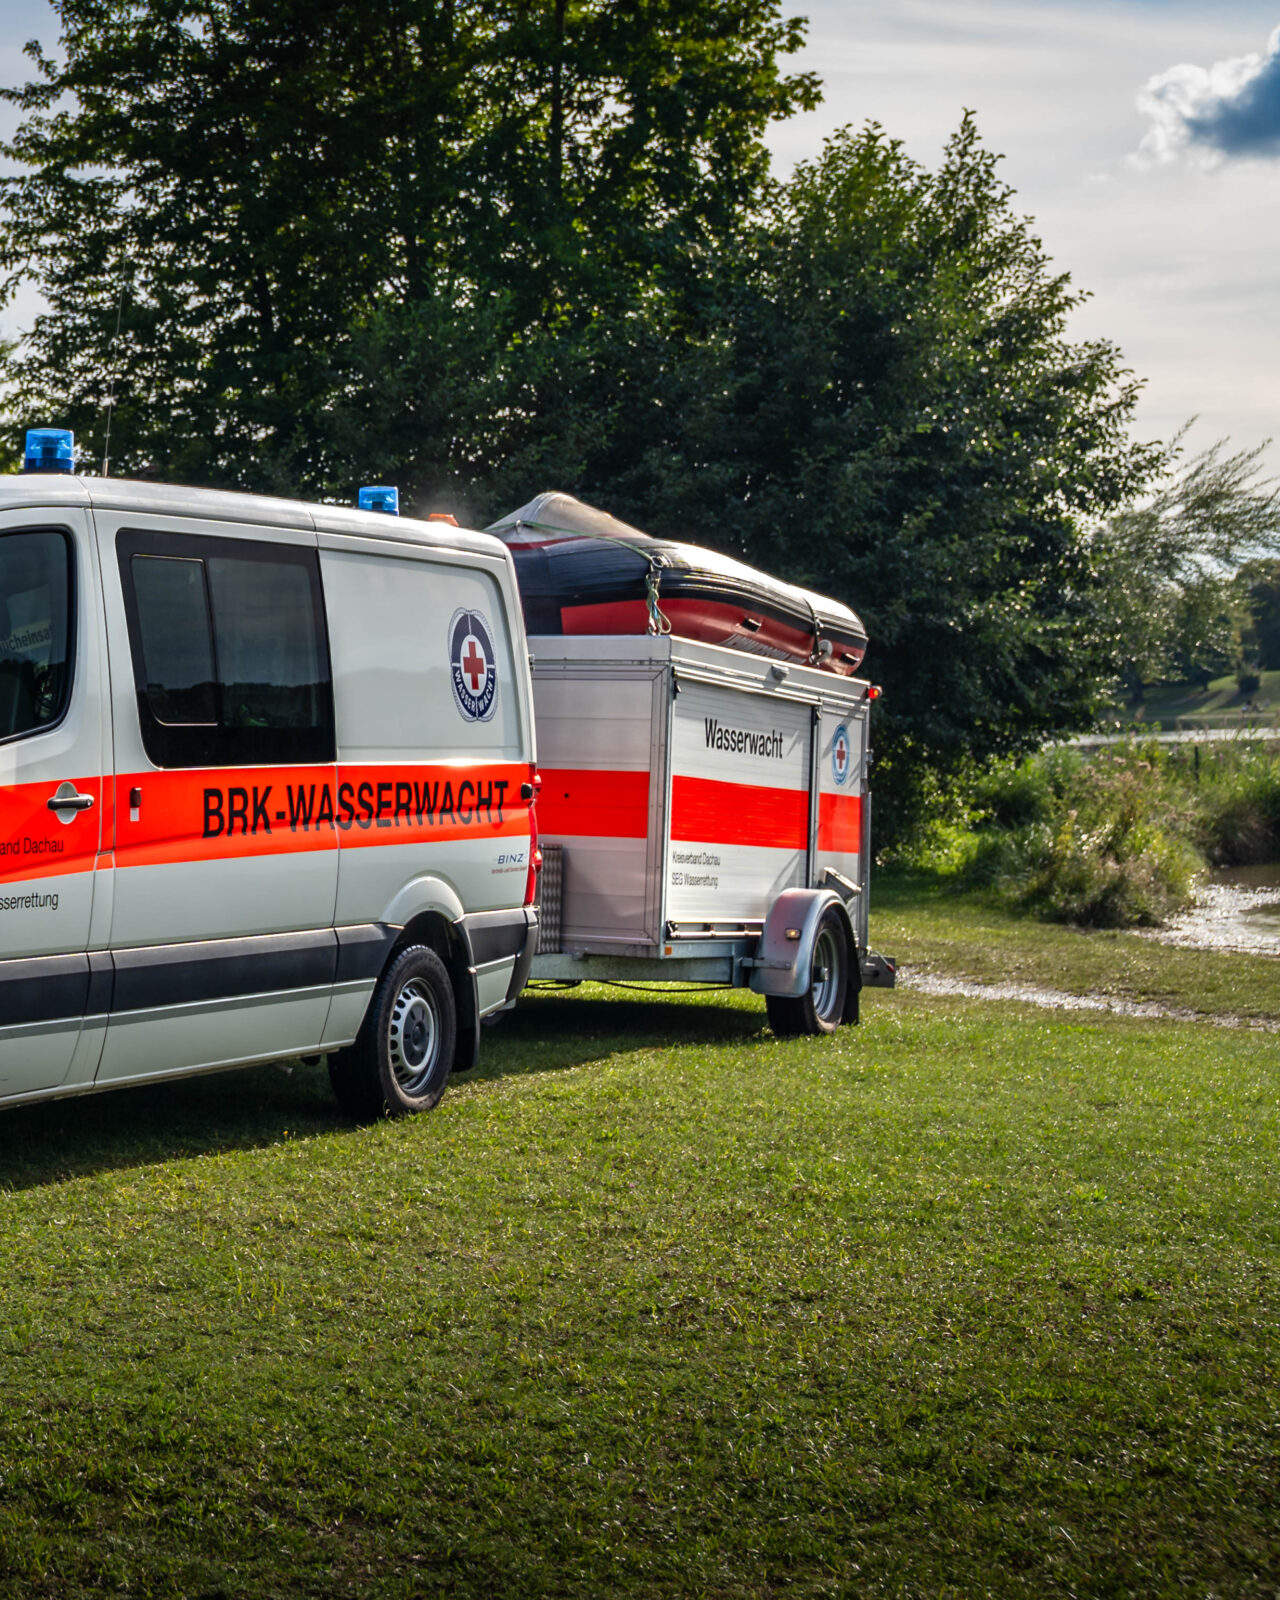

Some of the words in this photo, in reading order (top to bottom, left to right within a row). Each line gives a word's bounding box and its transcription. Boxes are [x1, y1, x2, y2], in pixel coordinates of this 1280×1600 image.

[455, 670, 476, 712] WASSER
[478, 671, 495, 712] WACHT
[705, 717, 783, 759] Wasserwacht
[202, 780, 509, 839] BRK-WASSERWACHT
[23, 837, 64, 854] Dachau
[497, 853, 524, 864] BINZ
